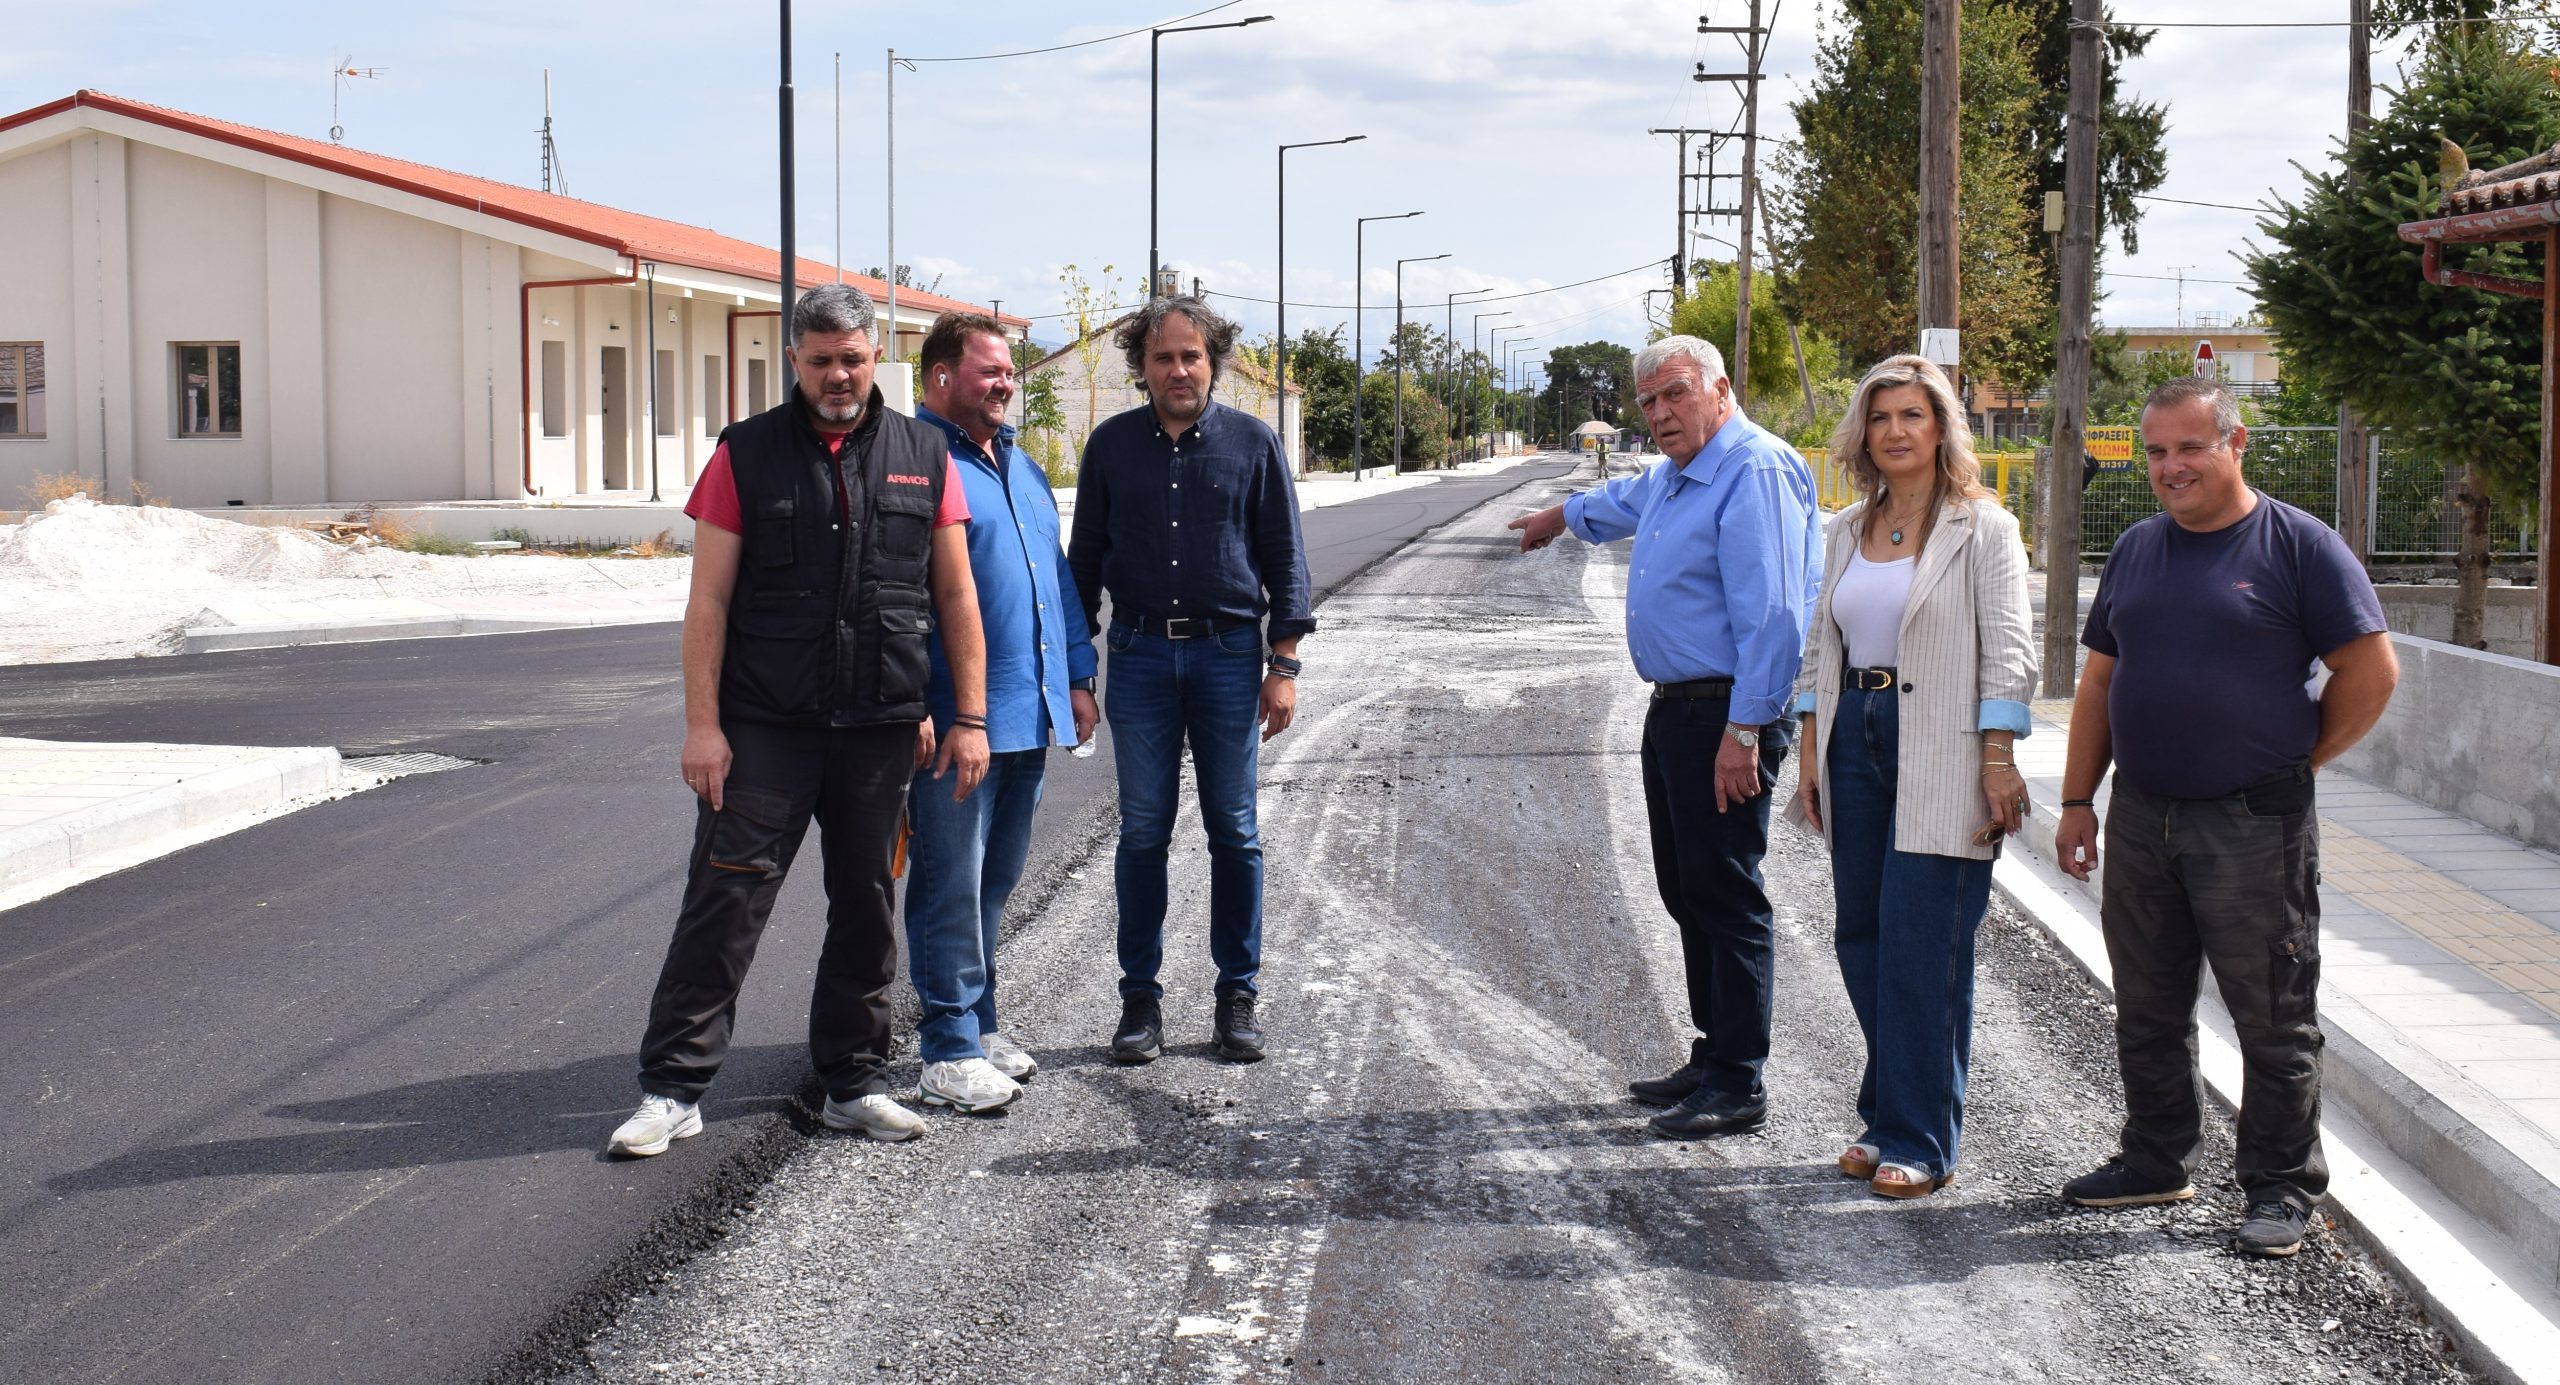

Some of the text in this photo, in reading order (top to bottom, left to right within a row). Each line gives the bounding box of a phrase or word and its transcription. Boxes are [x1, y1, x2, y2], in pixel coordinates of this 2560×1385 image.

[2197, 358, 2214, 379] STOP
[2098, 461, 2128, 469] 81317
[886, 474, 930, 486] ARMOS
